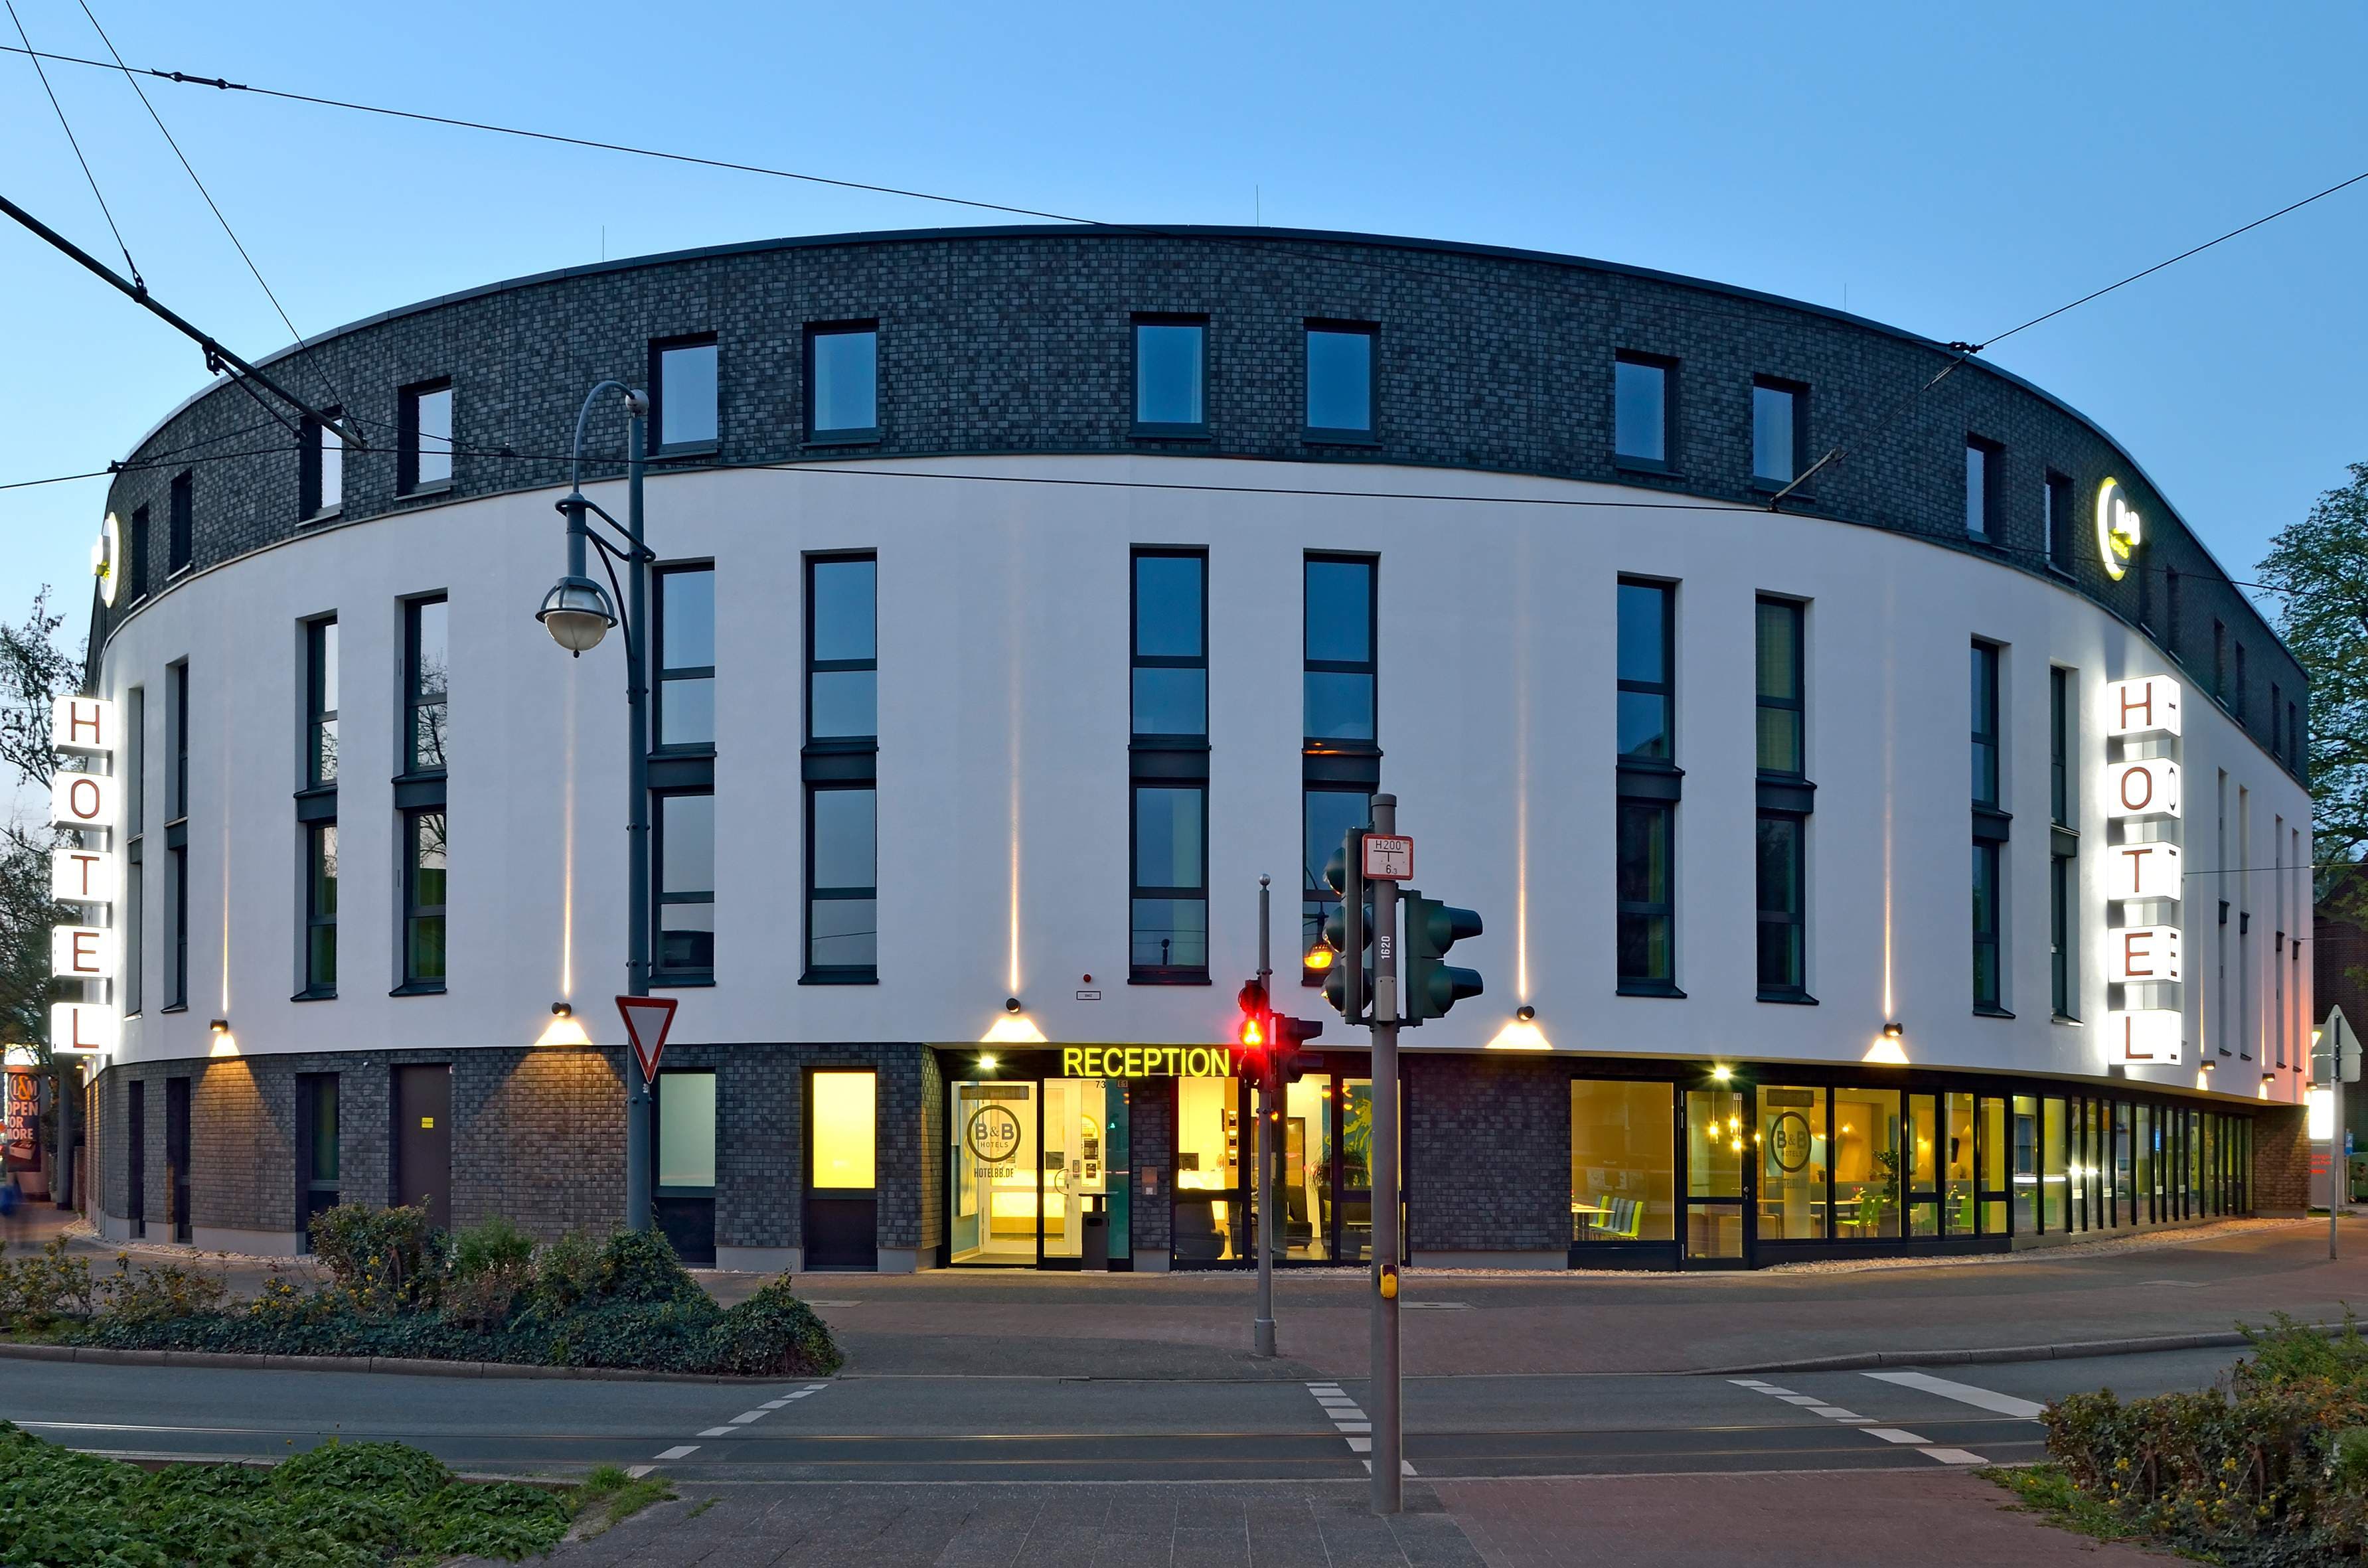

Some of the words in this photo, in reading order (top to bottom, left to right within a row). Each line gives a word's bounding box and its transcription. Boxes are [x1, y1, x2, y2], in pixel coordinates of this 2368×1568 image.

[1376, 840, 1401, 850] H200
[71, 701, 100, 1048] HOTEL
[2120, 682, 2153, 1059] HOTEL
[1381, 936, 1390, 959] 1620
[1064, 1048, 1229, 1077] RECEPTION
[7, 1117, 23, 1128] OR
[975, 1123, 1014, 1140] B&B
[1777, 1131, 1807, 1148] B&B
[974, 1168, 1014, 1178] HOTELBB.DE
